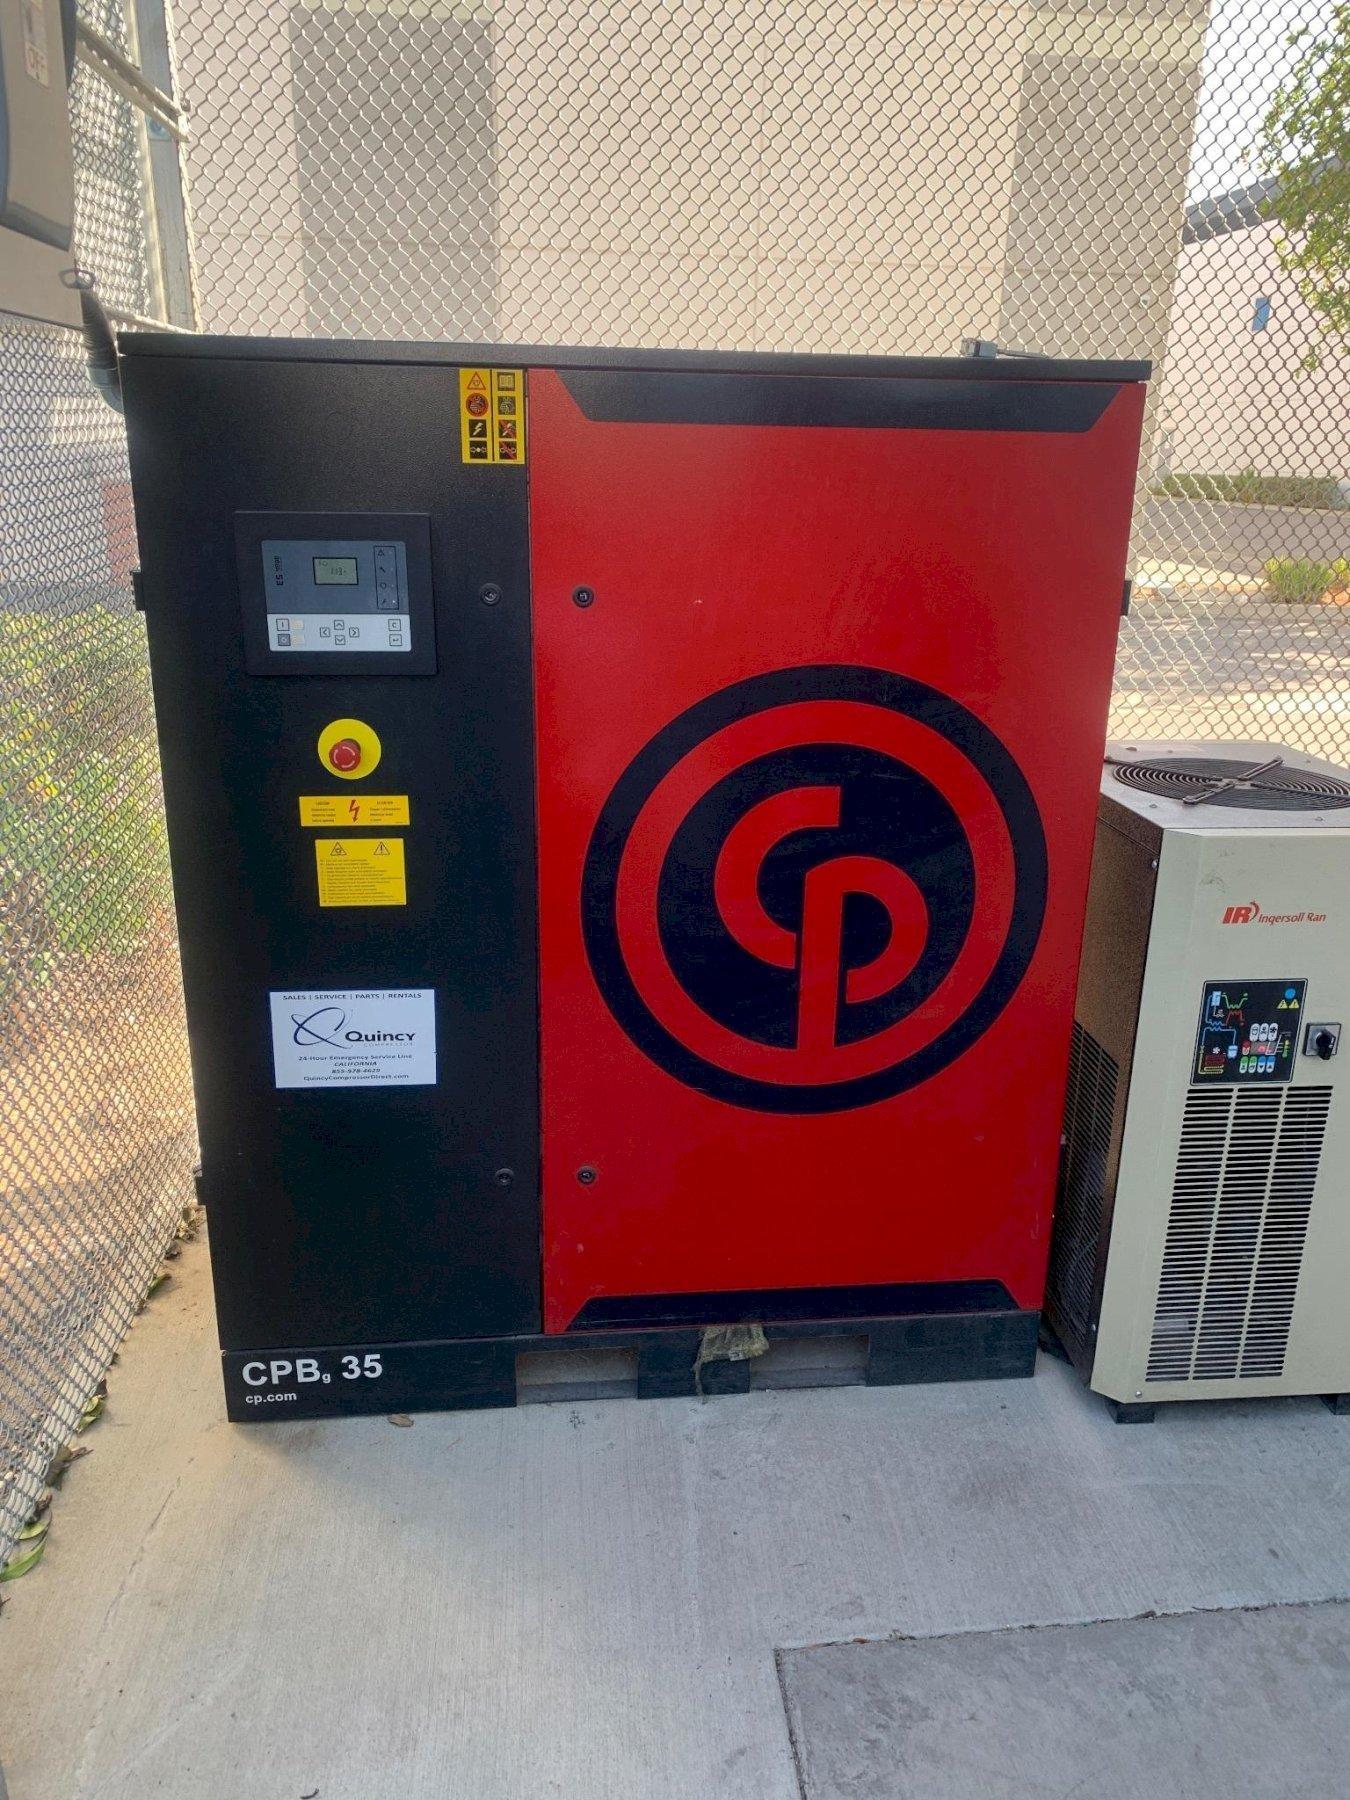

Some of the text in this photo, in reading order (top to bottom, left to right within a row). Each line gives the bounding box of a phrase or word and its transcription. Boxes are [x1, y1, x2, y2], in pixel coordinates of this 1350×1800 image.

[1258, 912, 1304, 925] Ingersoll
[344, 1030, 416, 1042] Quincy
[329, 1054, 369, 1062] Emergency
[341, 1353, 383, 1380] 35
[245, 1391, 297, 1405] cp.com
